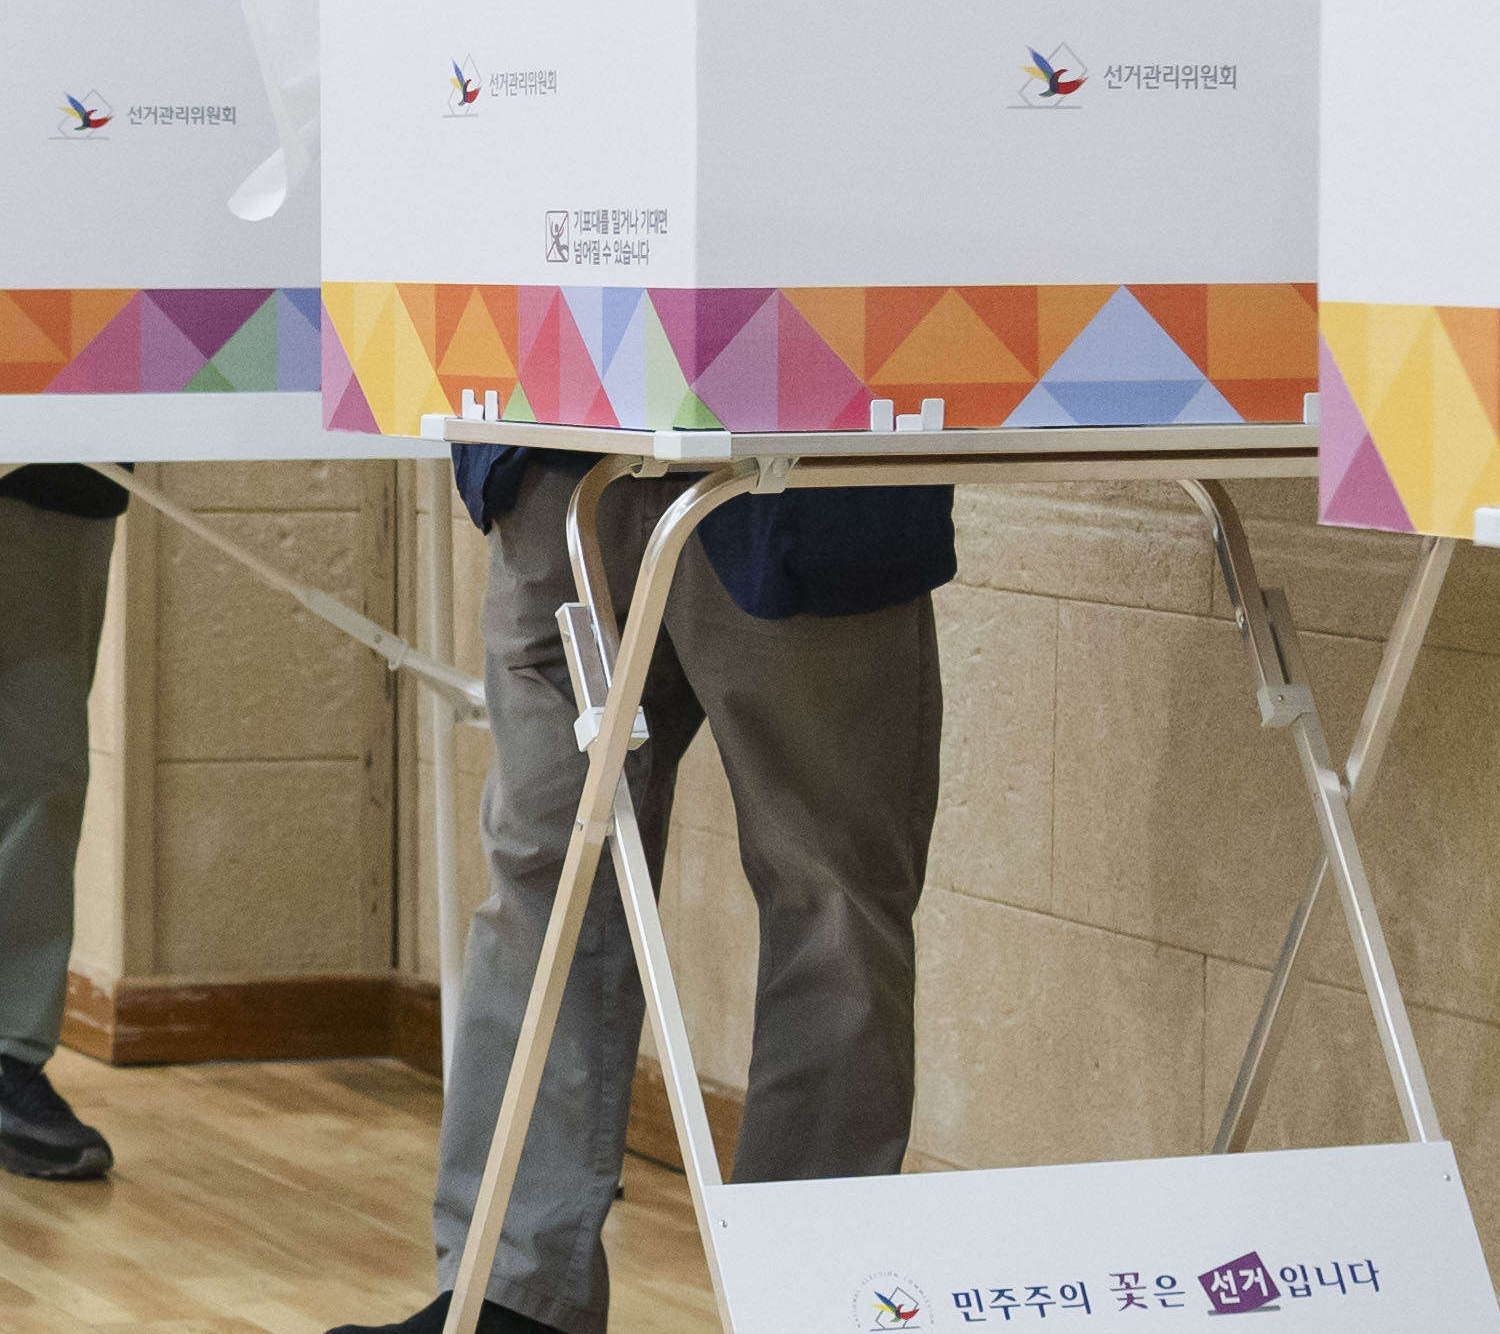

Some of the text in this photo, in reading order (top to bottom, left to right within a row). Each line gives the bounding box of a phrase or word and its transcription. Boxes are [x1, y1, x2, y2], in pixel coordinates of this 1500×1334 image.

[489, 69, 557, 97] 선거관리위원회
[1104, 64, 1237, 90] 선거관리위원회
[128, 106, 236, 125] 선거관리위원회
[573, 209, 668, 234] 기표대를 밀거나 기대면
[573, 240, 649, 265] 넘어질 수 있습니다
[952, 1281, 1092, 1322] 민주주의
[1109, 1272, 1185, 1311] 꽃은
